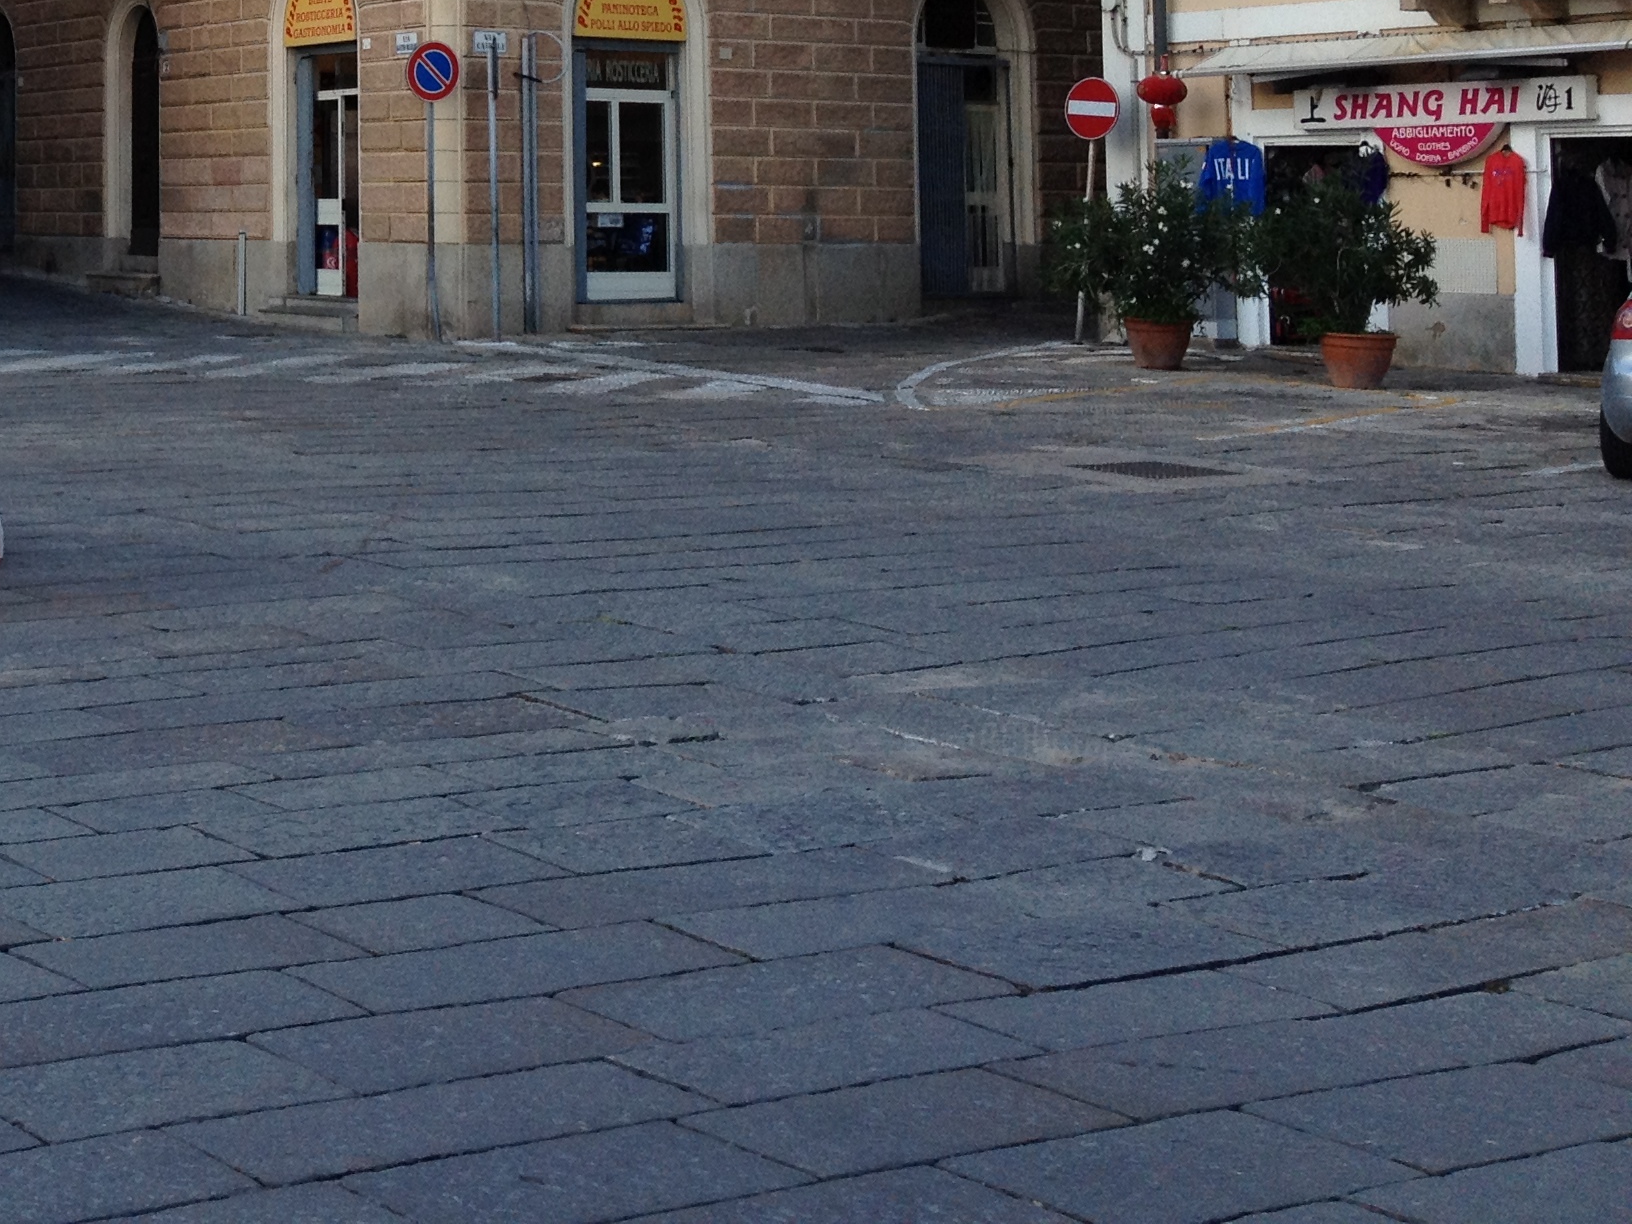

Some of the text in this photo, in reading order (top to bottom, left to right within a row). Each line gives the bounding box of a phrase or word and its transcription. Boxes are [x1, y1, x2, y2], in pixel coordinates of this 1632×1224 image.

[295, 7, 344, 23] ROSTICCERIA
[601, 2, 660, 17] PANINOTECA
[293, 23, 346, 39] GASTRONOMIA
[590, 18, 673, 34] POLLI ALLO SPIEDO
[1333, 85, 1520, 123] SHANG HAI
[1565, 89, 1574, 111] 1
[1300, 95, 1327, 124] 上
[1391, 125, 1475, 139] ABBIGLIAMENTO
[1389, 136, 1479, 164] UOMO DONNA BAMBINO
[1417, 141, 1451, 151] CLOTHES
[1213, 157, 1255, 181] ITALI
